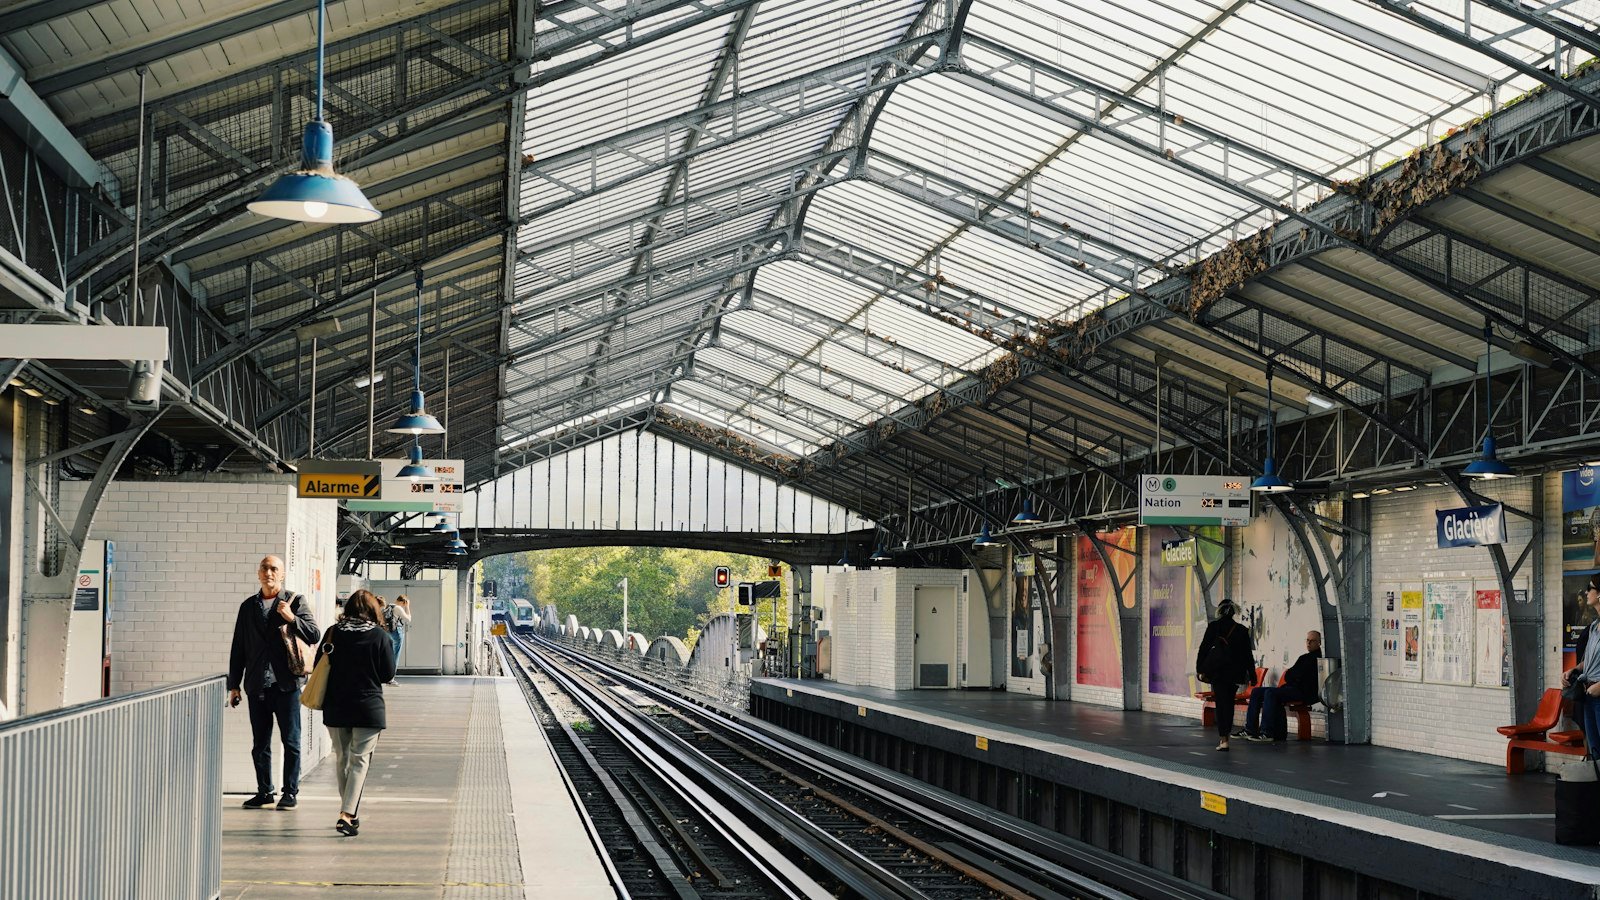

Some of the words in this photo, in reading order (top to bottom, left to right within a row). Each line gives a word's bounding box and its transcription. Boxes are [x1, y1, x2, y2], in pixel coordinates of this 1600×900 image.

[1580, 467, 1594, 477] video
[305, 480, 360, 494] Alarme
[1166, 480, 1172, 489] 6
[1145, 497, 1181, 508] Nation
[1202, 498, 1214, 508] 04
[1444, 512, 1495, 541] Glacière
[1166, 542, 1192, 562] Glacière
